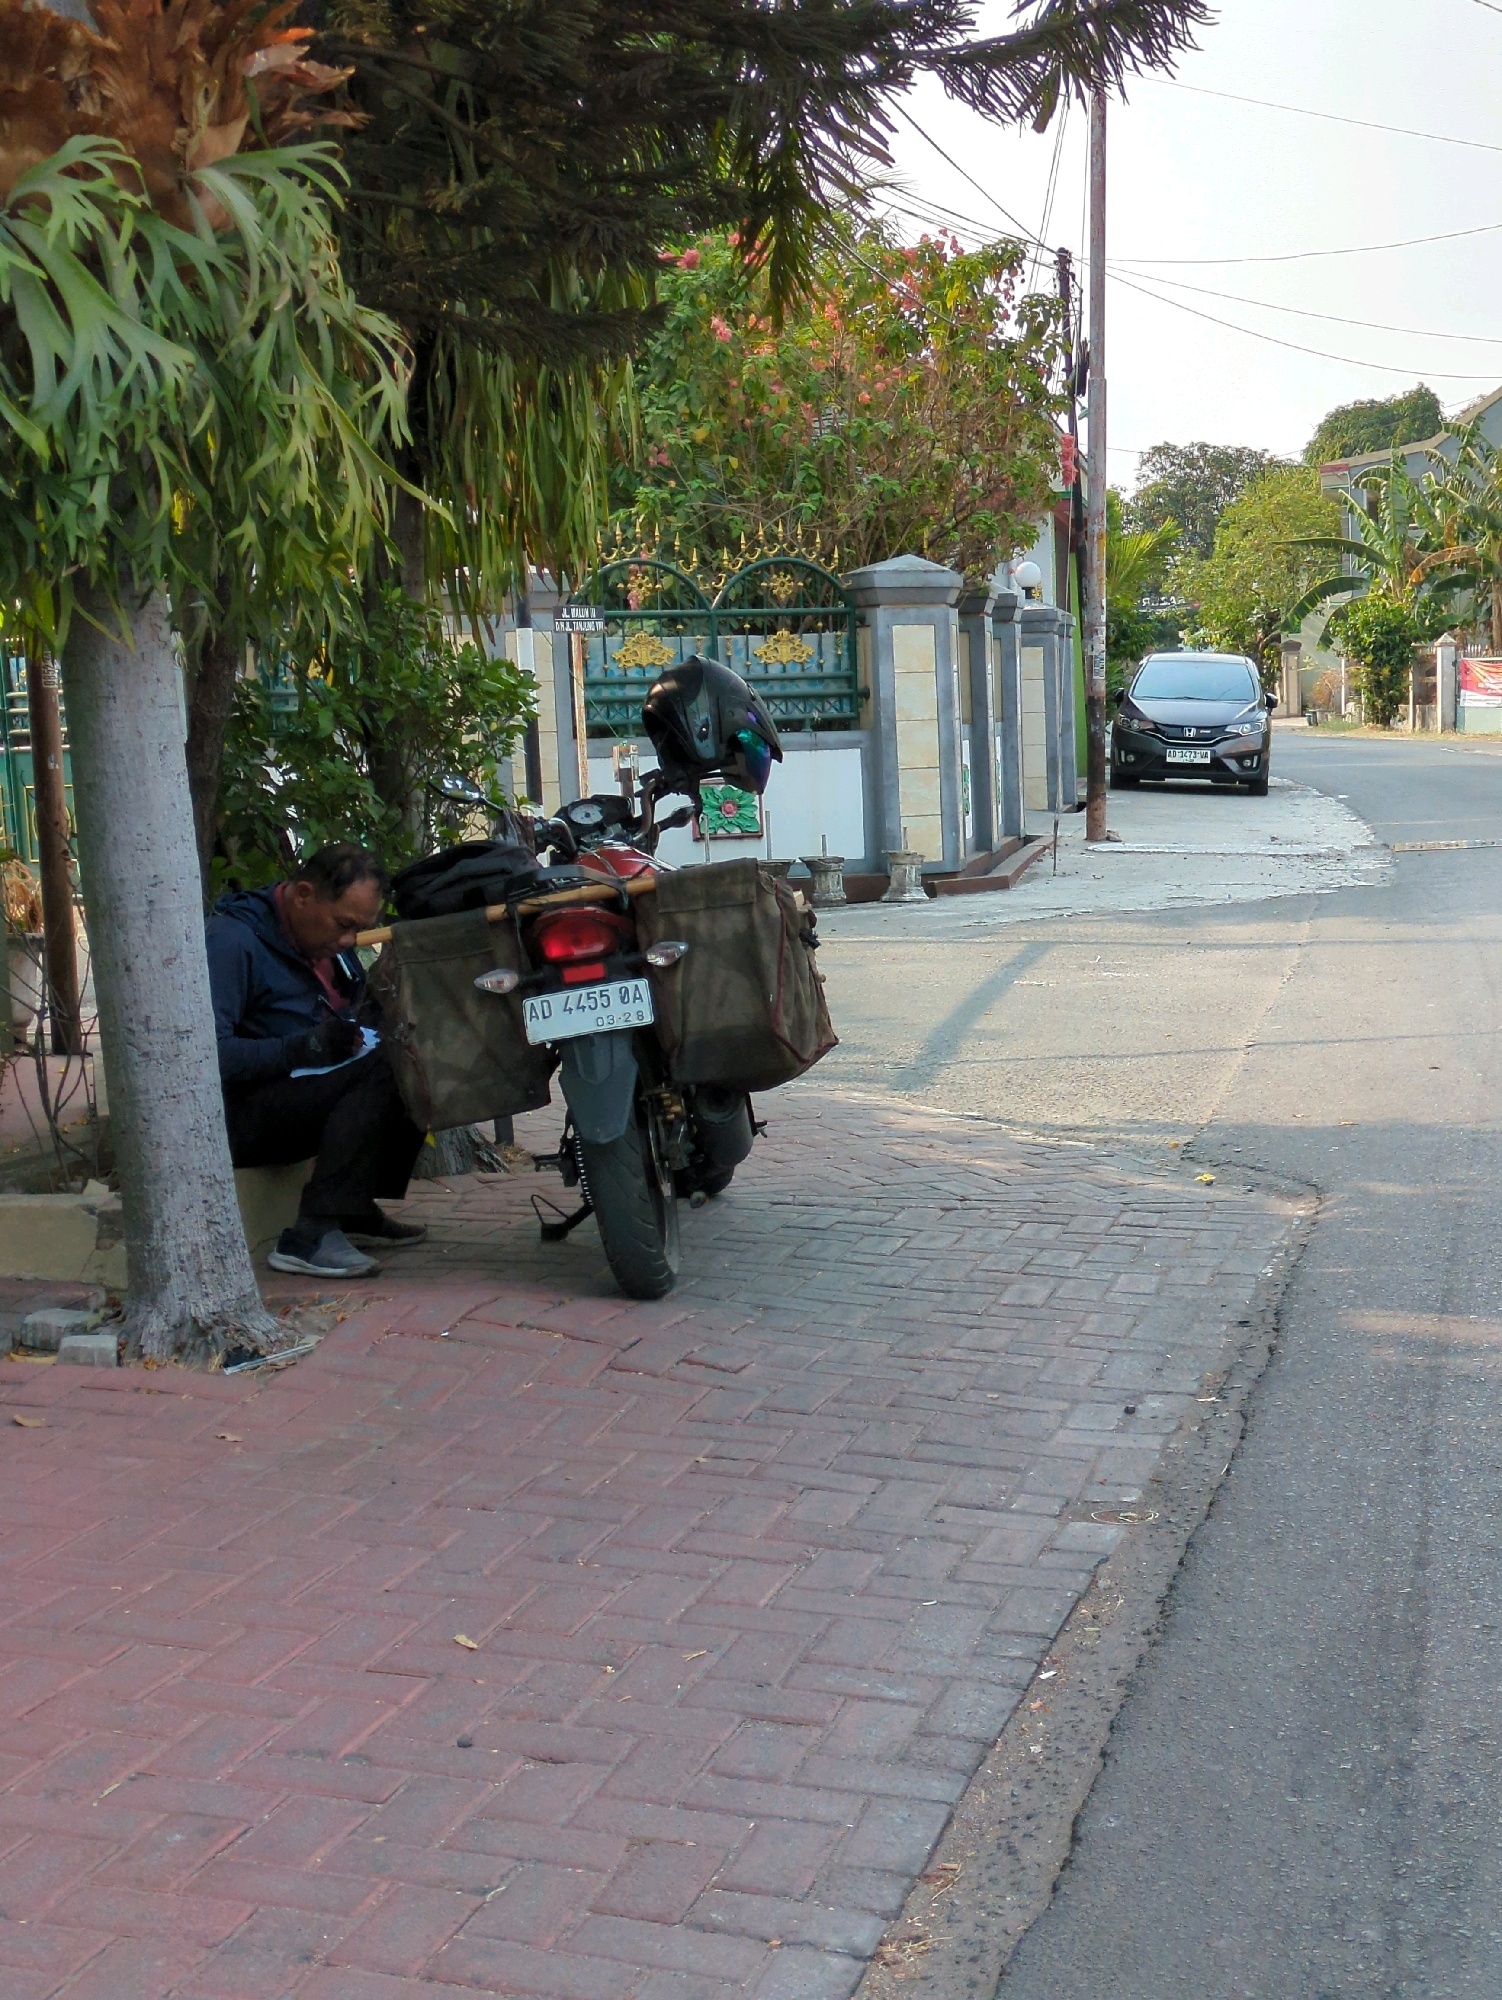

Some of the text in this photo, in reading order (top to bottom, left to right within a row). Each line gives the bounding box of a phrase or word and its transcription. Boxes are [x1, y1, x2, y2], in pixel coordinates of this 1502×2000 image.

[1167, 750, 1177, 758] AD
[529, 998, 553, 1022] AD
[562, 989, 611, 1014] 4455
